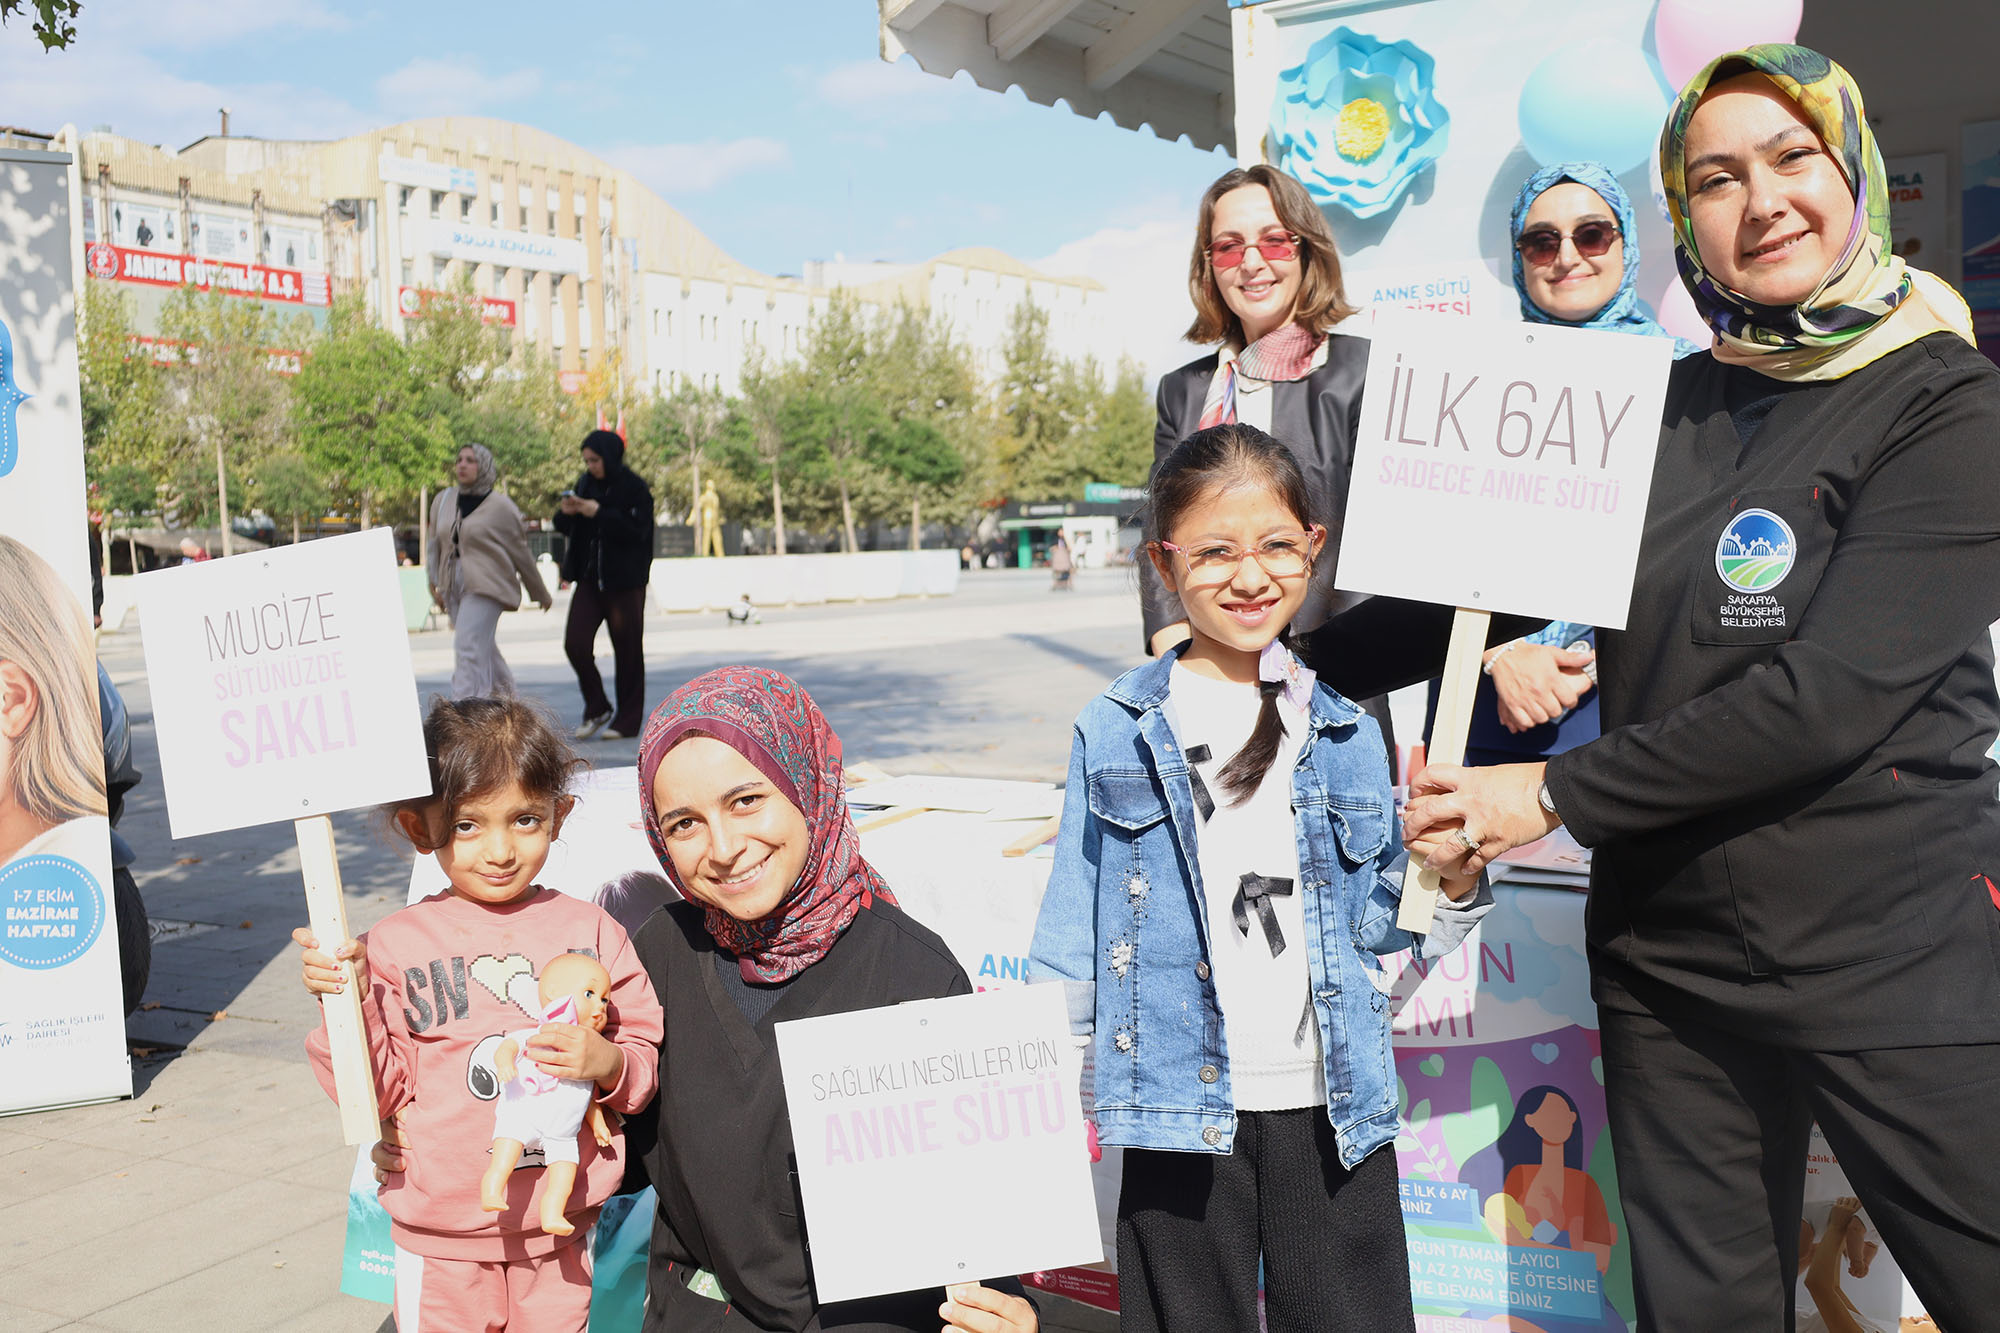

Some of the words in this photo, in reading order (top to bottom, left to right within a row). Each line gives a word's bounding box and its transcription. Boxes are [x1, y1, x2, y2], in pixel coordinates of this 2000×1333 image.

[1373, 285, 1420, 302] ANNE
[1424, 276, 1471, 298] SÜTÜ
[1384, 353, 1480, 452] İLK
[1378, 454, 1475, 496] SADECE
[1479, 467, 1549, 505] ANNE
[1554, 474, 1621, 515] SÜTÜ
[1720, 604, 1785, 618] BÜYÜKŞEHİR
[1727, 594, 1778, 606] SAKARYA
[204, 592, 341, 662] MUCİZE
[1721, 614, 1786, 627] BELEDİYESİ
[213, 650, 347, 702] SÜTÜNÜZDE
[220, 689, 358, 769] SAKLI
[13, 889, 32, 902] 1-7
[37, 887, 74, 903] EKİM
[6, 903, 79, 921] EMZİRME
[7, 924, 76, 939] HAFTASI
[811, 1061, 908, 1102] SAĞLIKLI
[912, 1046, 1014, 1087] NESİLLER
[1016, 1036, 1059, 1076] İÇİN
[824, 1098, 943, 1167] ANNE
[952, 1071, 1067, 1148] SÜTÜ
[1413, 1182, 1436, 1198] İLK
[1439, 1187, 1447, 1199] 6
[1450, 1188, 1468, 1200] AY
[1448, 1244, 1561, 1269] TAMAMLAYICI
[1426, 1263, 1448, 1277] AZ
[1451, 1264, 1460, 1278] 2
[1463, 1265, 1495, 1285] YAŞ
[1498, 1270, 1521, 1286] VE
[1525, 1271, 1598, 1294] ÖTESİNE
[1437, 1281, 1494, 1302] DEVAM
[1498, 1289, 1554, 1310] EDİNİZ
